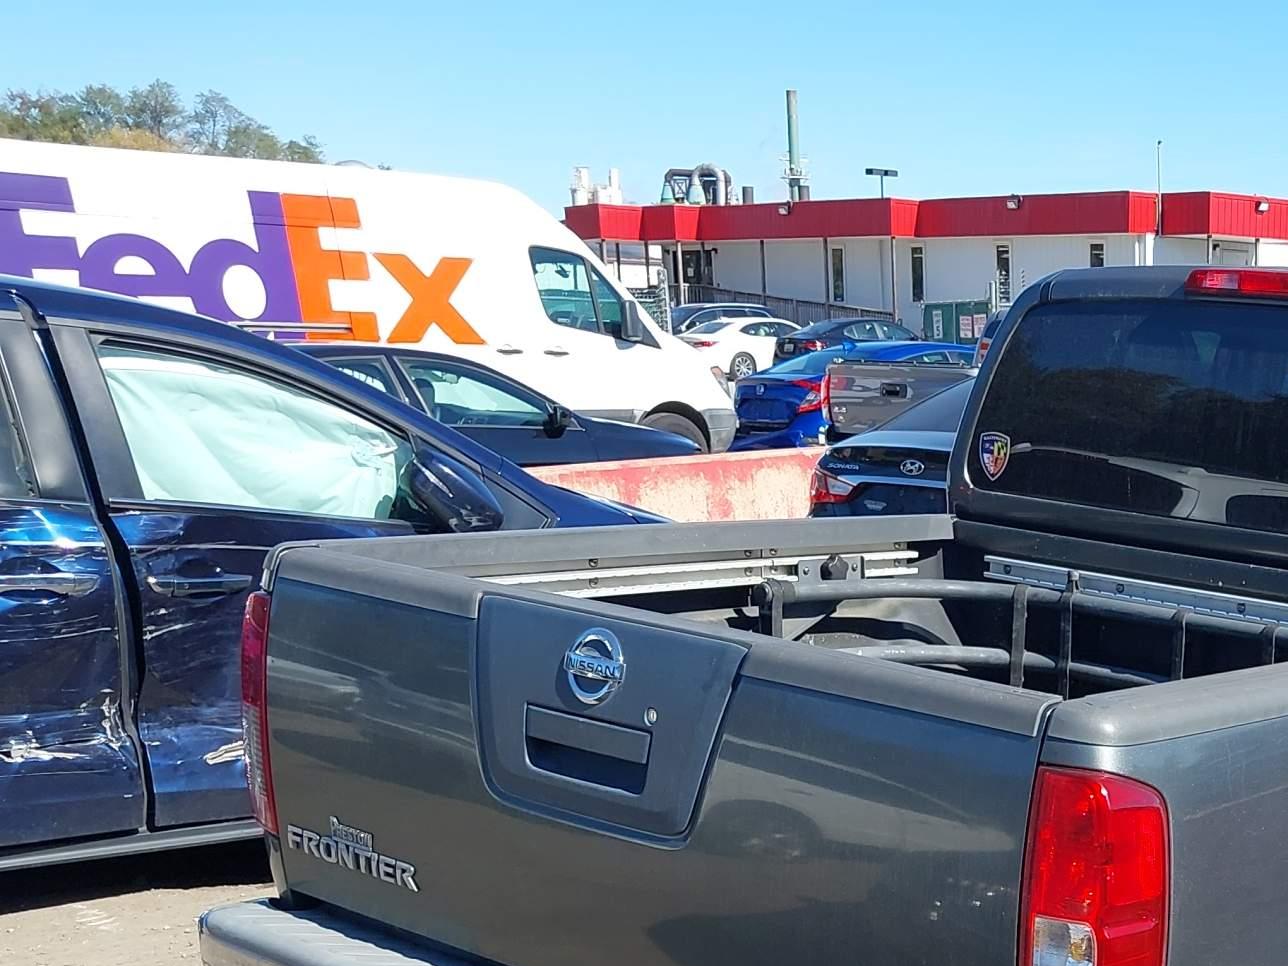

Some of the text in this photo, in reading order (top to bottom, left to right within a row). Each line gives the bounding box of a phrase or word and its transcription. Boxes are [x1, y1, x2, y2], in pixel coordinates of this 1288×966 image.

[0, 171, 487, 345] FedEx
[827, 462, 859, 471] SONATA
[568, 655, 617, 677] NISSAN
[287, 824, 420, 892] FRONTIER
